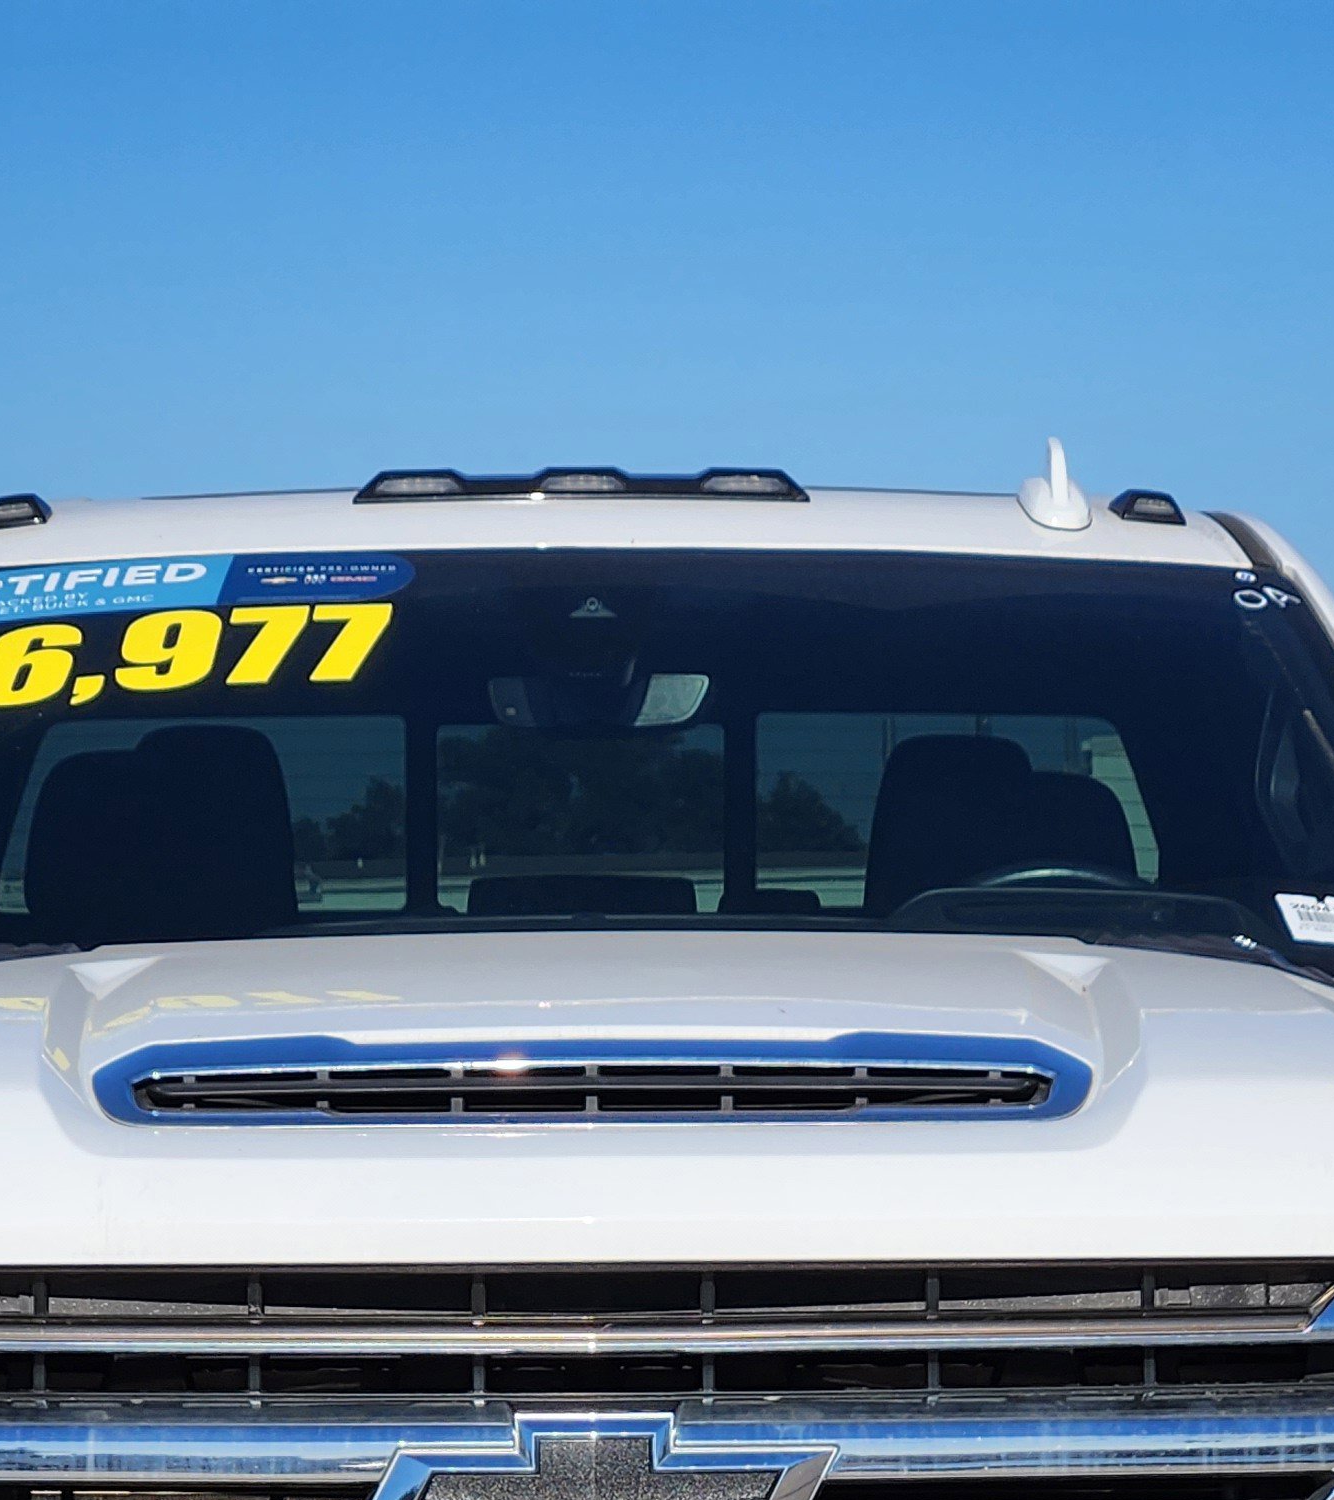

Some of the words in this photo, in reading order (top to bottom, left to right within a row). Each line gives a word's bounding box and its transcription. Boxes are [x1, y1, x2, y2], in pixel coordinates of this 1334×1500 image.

[32, 600, 88, 611] BUICK
[112, 594, 154, 604] GMC
[64, 592, 88, 601] BY
